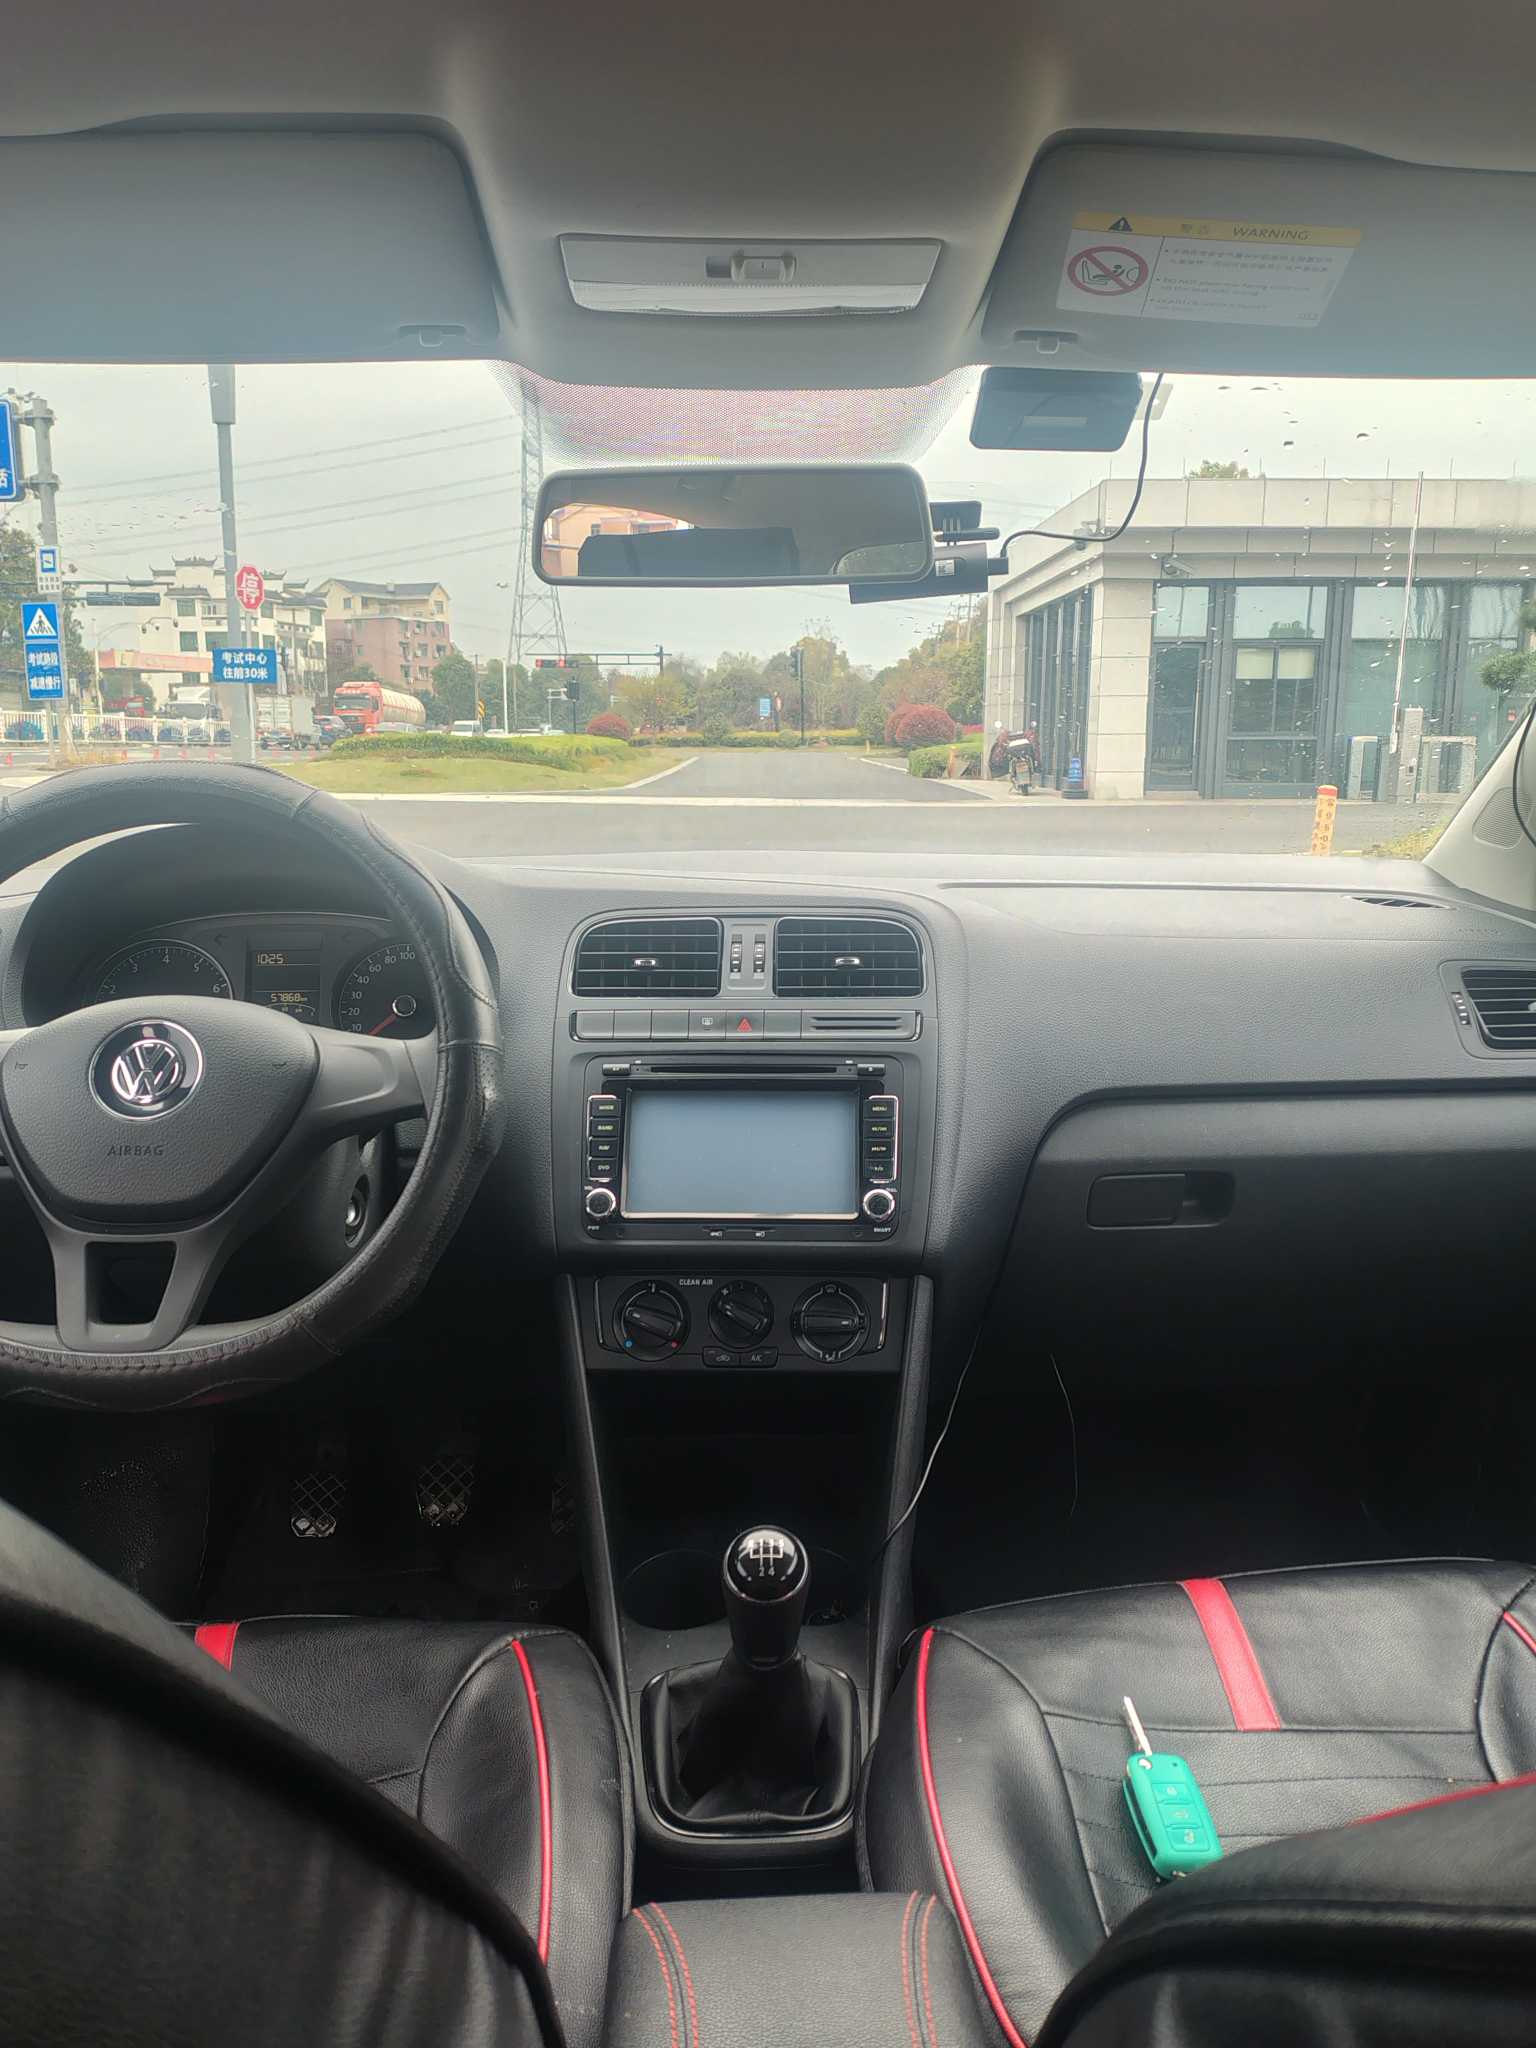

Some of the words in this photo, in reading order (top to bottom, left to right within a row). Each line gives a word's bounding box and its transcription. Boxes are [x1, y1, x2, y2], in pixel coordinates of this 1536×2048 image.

[1231, 226, 1311, 241] WARNING
[238, 571, 260, 604] 停
[222, 652, 268, 664] 考试中心
[223, 667, 268, 680] 往前30米
[162, 954, 169, 964] 4
[384, 955, 397, 964] 80
[400, 951, 416, 960] 100
[193, 962, 200, 973] 5
[368, 964, 382, 973] 60
[357, 975, 370, 984] 40
[212, 983, 220, 993] 6
[351, 991, 362, 1000] 30
[348, 1007, 360, 1016] 20
[351, 1023, 362, 1032] 10
[107, 1144, 164, 1157] AIRBAG
